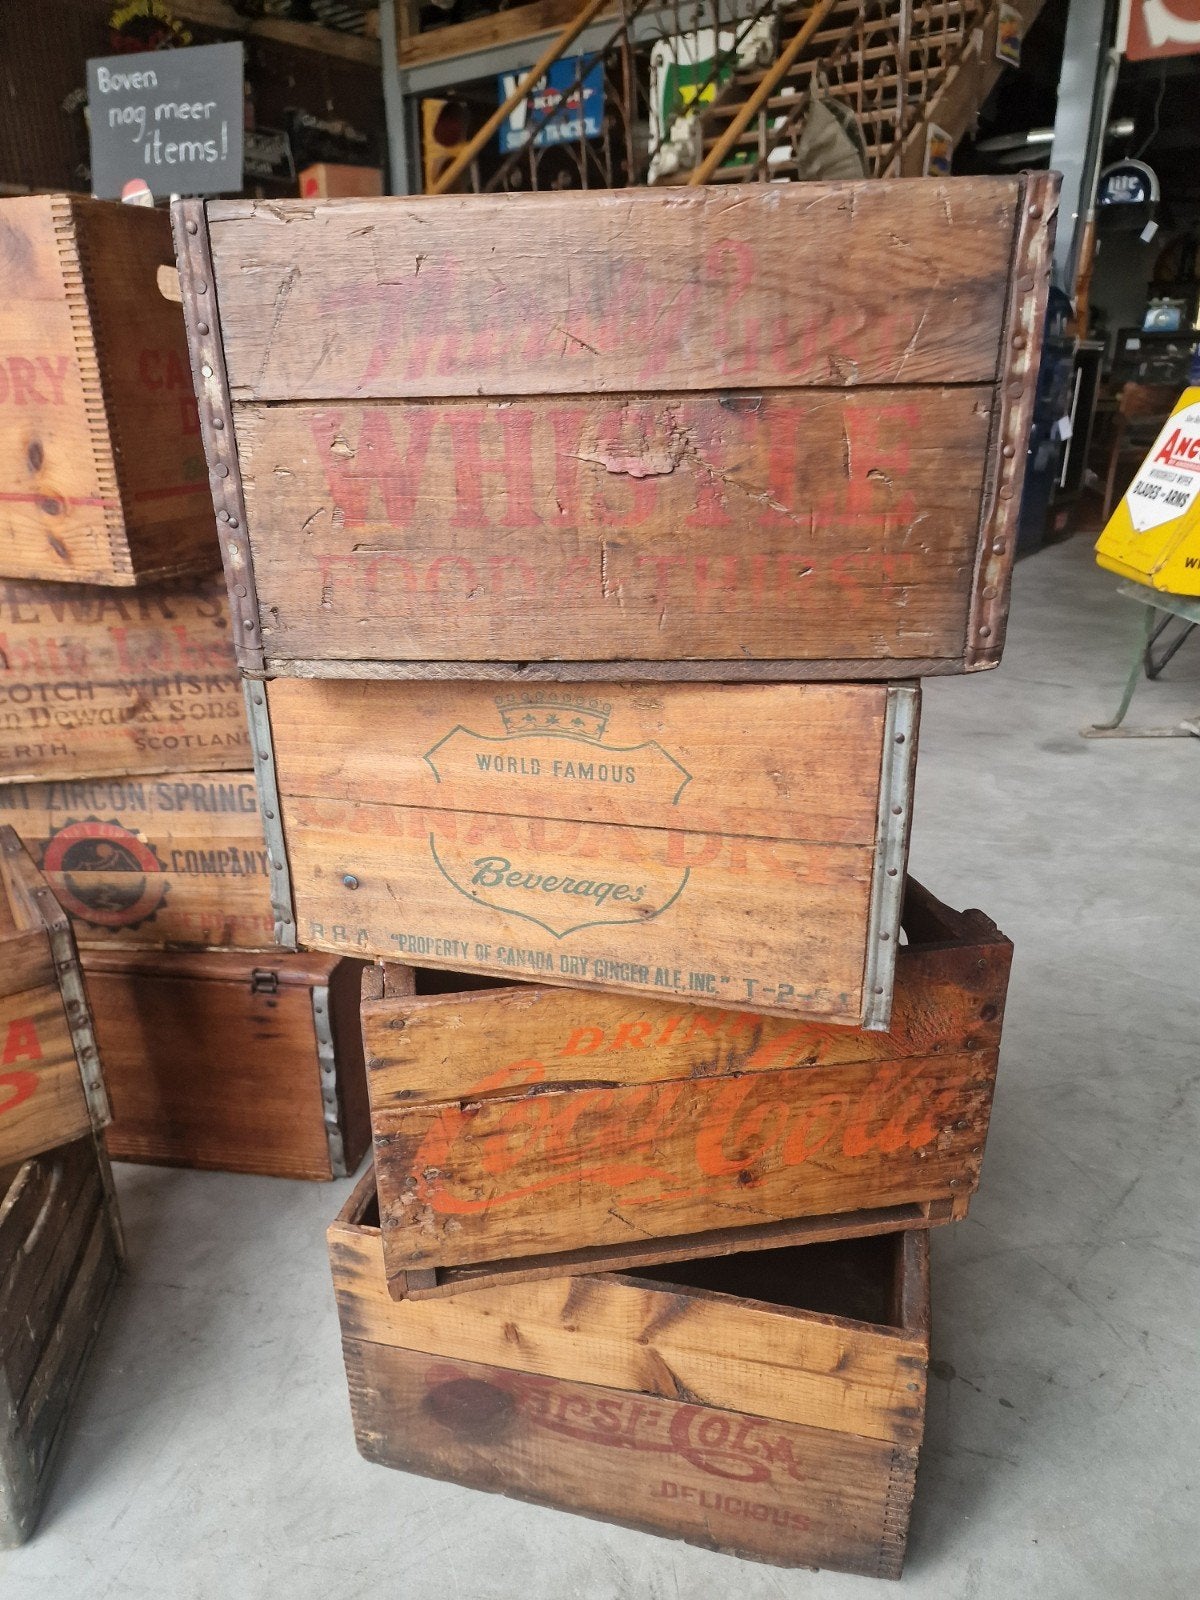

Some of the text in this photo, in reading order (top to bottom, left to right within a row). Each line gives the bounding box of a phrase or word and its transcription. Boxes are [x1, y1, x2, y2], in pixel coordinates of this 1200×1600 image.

[97, 66, 158, 93] Boven
[108, 101, 217, 143] nog meer
[144, 120, 228, 165] items!
[0, 355, 70, 406] RY
[310, 405, 926, 530] WHISTLE
[1154, 428, 1200, 465] ANC
[0, 742, 77, 759] ERTH,
[476, 753, 636, 784] WORLD FAMOUS
[45, 782, 147, 813] ZIRCON
[155, 782, 257, 813] SPRING
[300, 783, 846, 886] CANADA DRY
[170, 847, 269, 878] COMPANY
[471, 855, 646, 905] Beverages
[475, 943, 493, 962] OF
[497, 946, 554, 971] CANADA
[560, 953, 589, 977] DRY
[594, 958, 650, 985] GINGER
[659, 1479, 812, 1532] DELICIOUS
